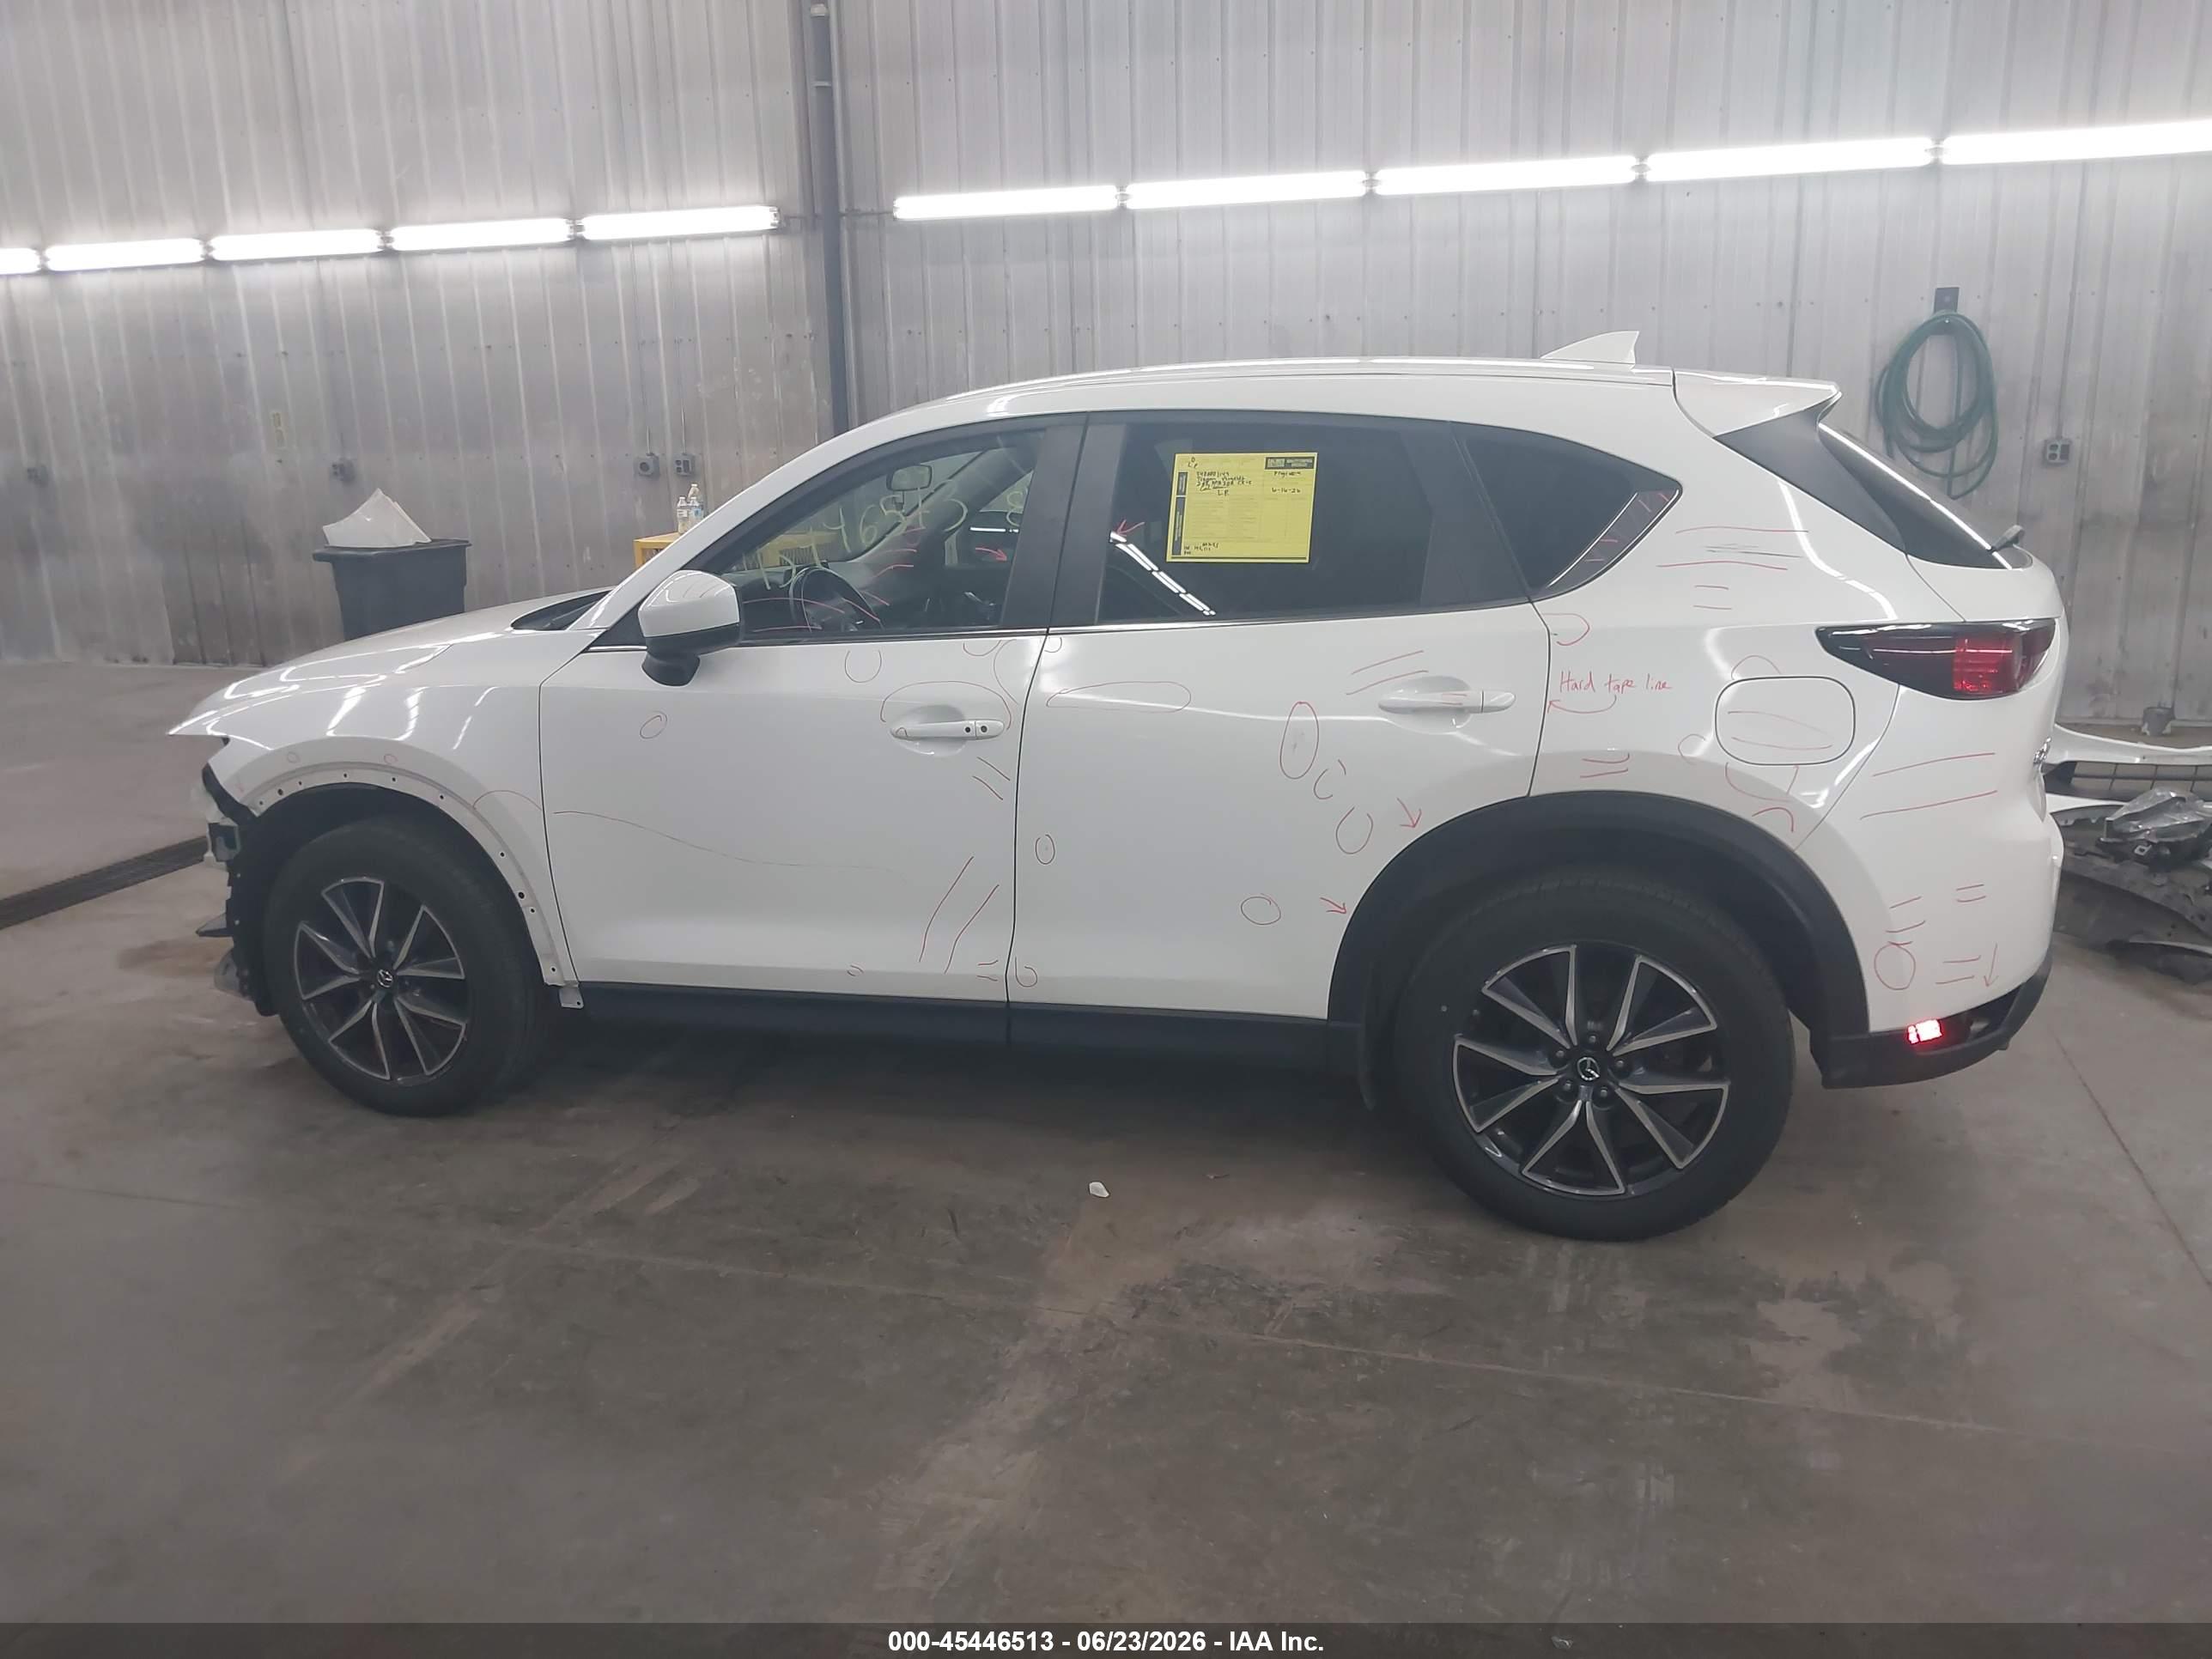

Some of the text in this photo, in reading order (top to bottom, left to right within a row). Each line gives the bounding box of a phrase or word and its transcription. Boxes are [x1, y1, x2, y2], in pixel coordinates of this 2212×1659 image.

[1559, 671, 1673, 694] Hard tape line
